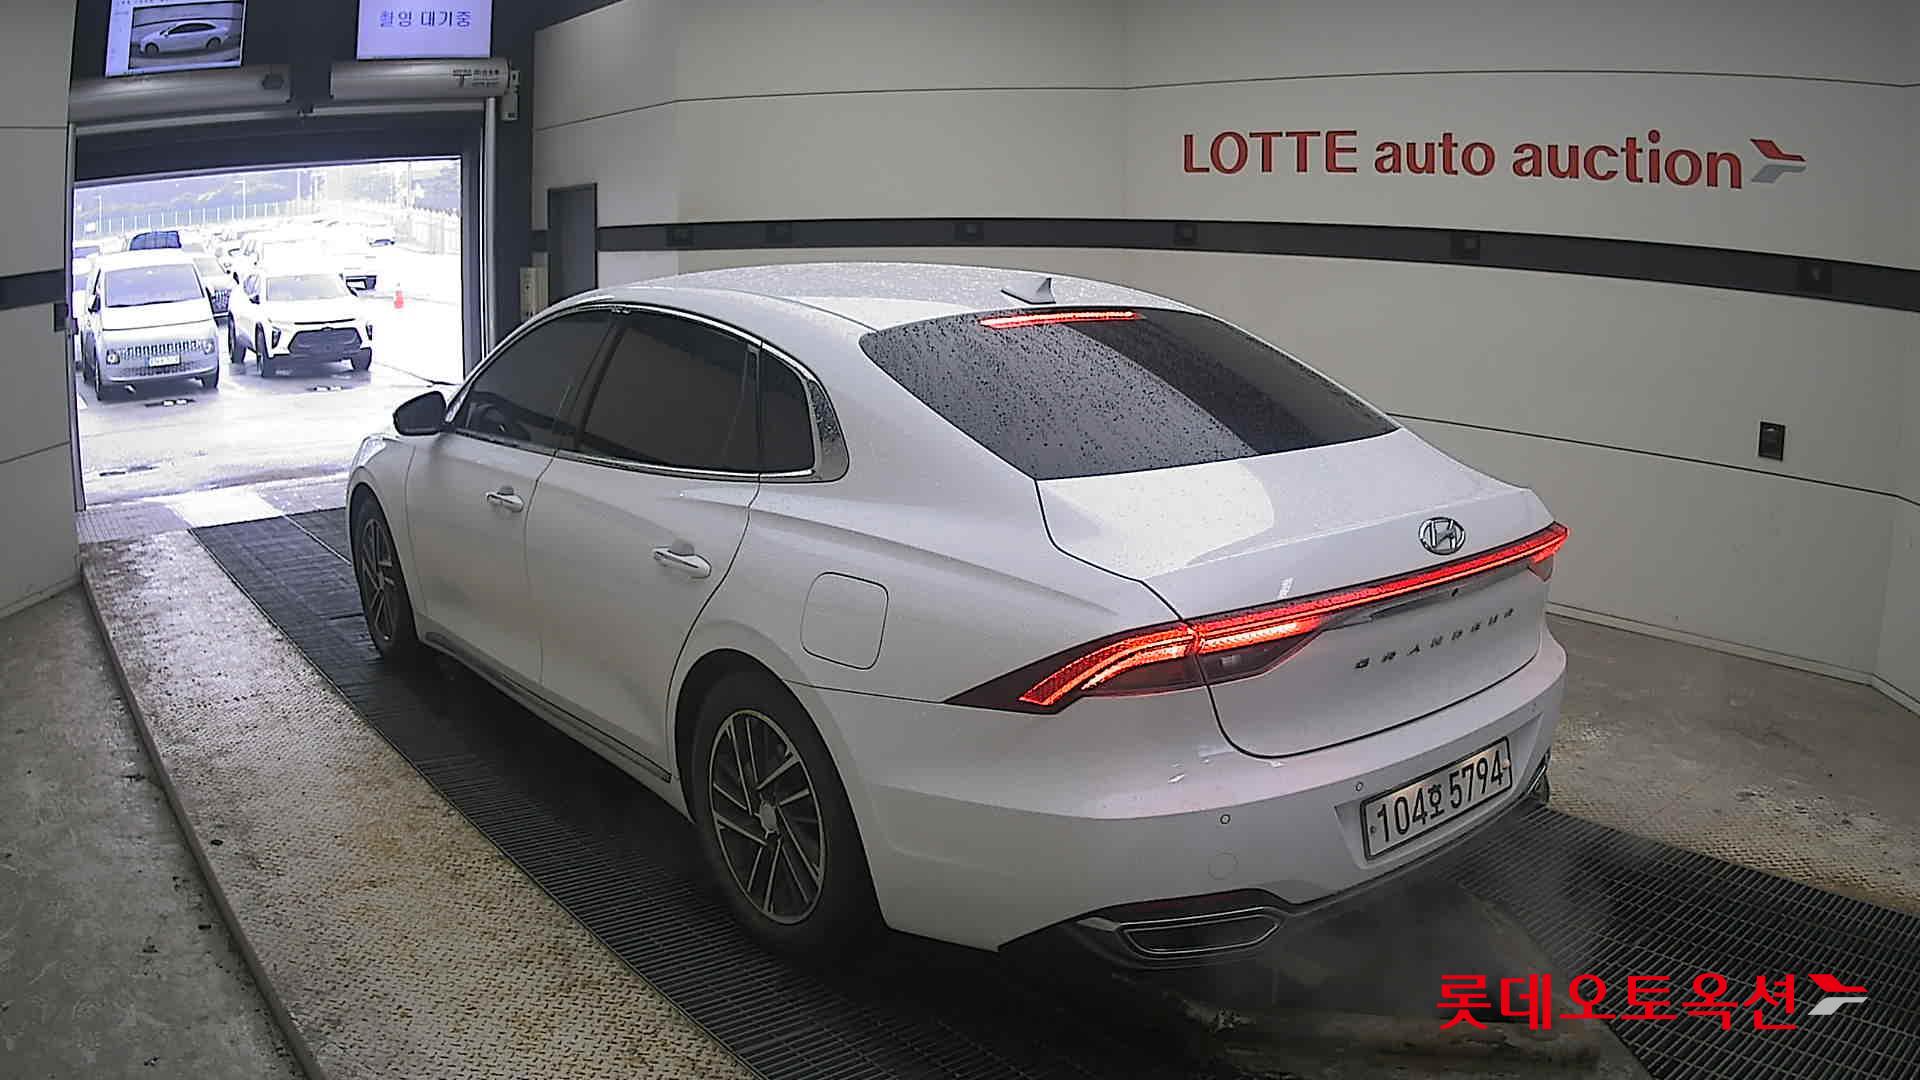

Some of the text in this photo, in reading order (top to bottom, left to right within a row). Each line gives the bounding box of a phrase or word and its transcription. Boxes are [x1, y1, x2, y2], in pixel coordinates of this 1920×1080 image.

[420, 10, 472, 28] 대기중
[1184, 130, 1742, 188] LOTTE auto auction
[1377, 750, 1504, 843] 104호 5794
